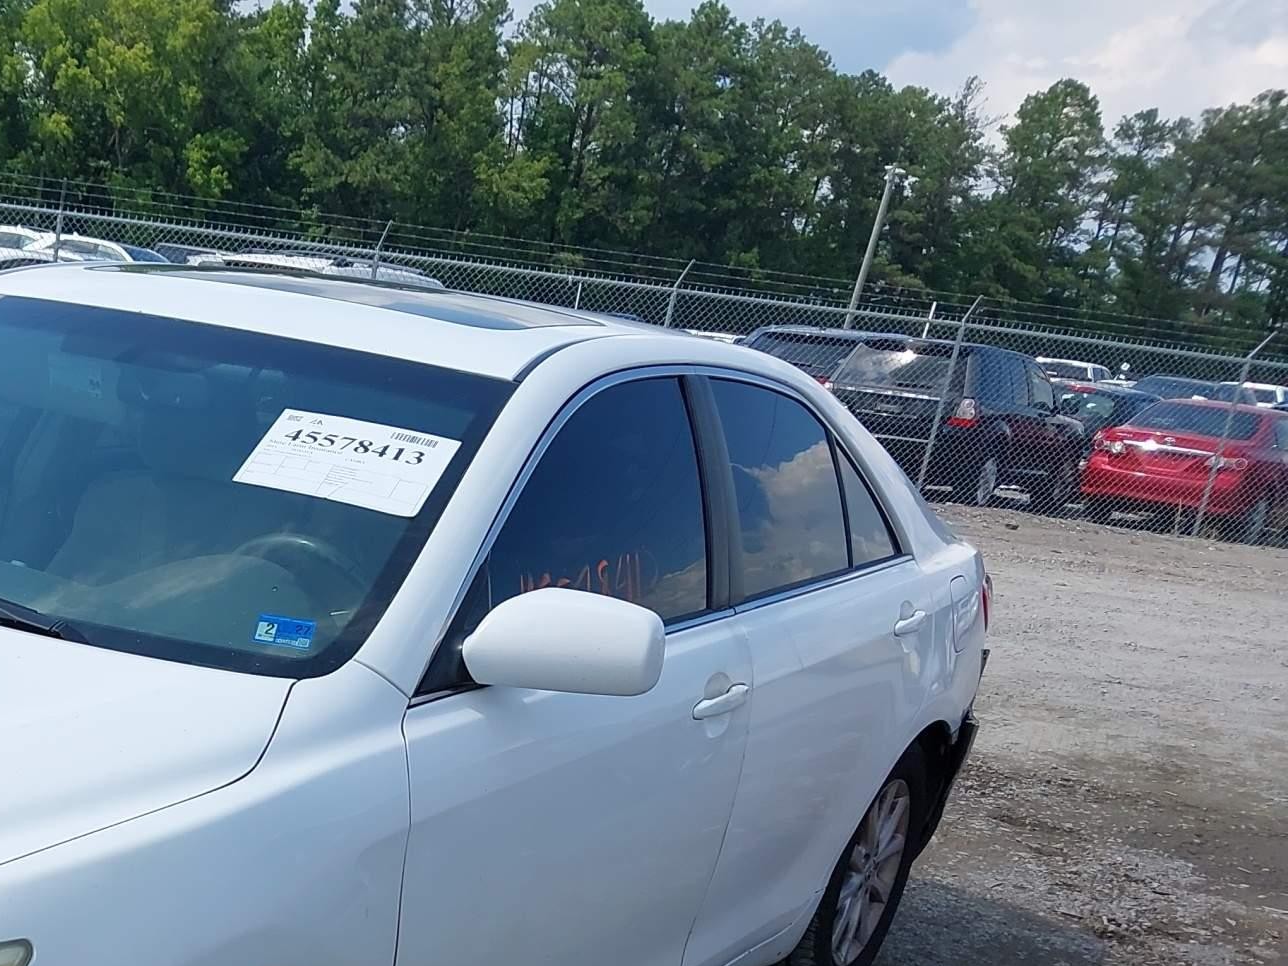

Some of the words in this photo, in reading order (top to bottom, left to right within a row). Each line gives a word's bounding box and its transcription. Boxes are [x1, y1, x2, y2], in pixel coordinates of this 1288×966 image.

[285, 429, 425, 465] 45578413
[265, 623, 275, 635] 2
[296, 625, 311, 635] 27
